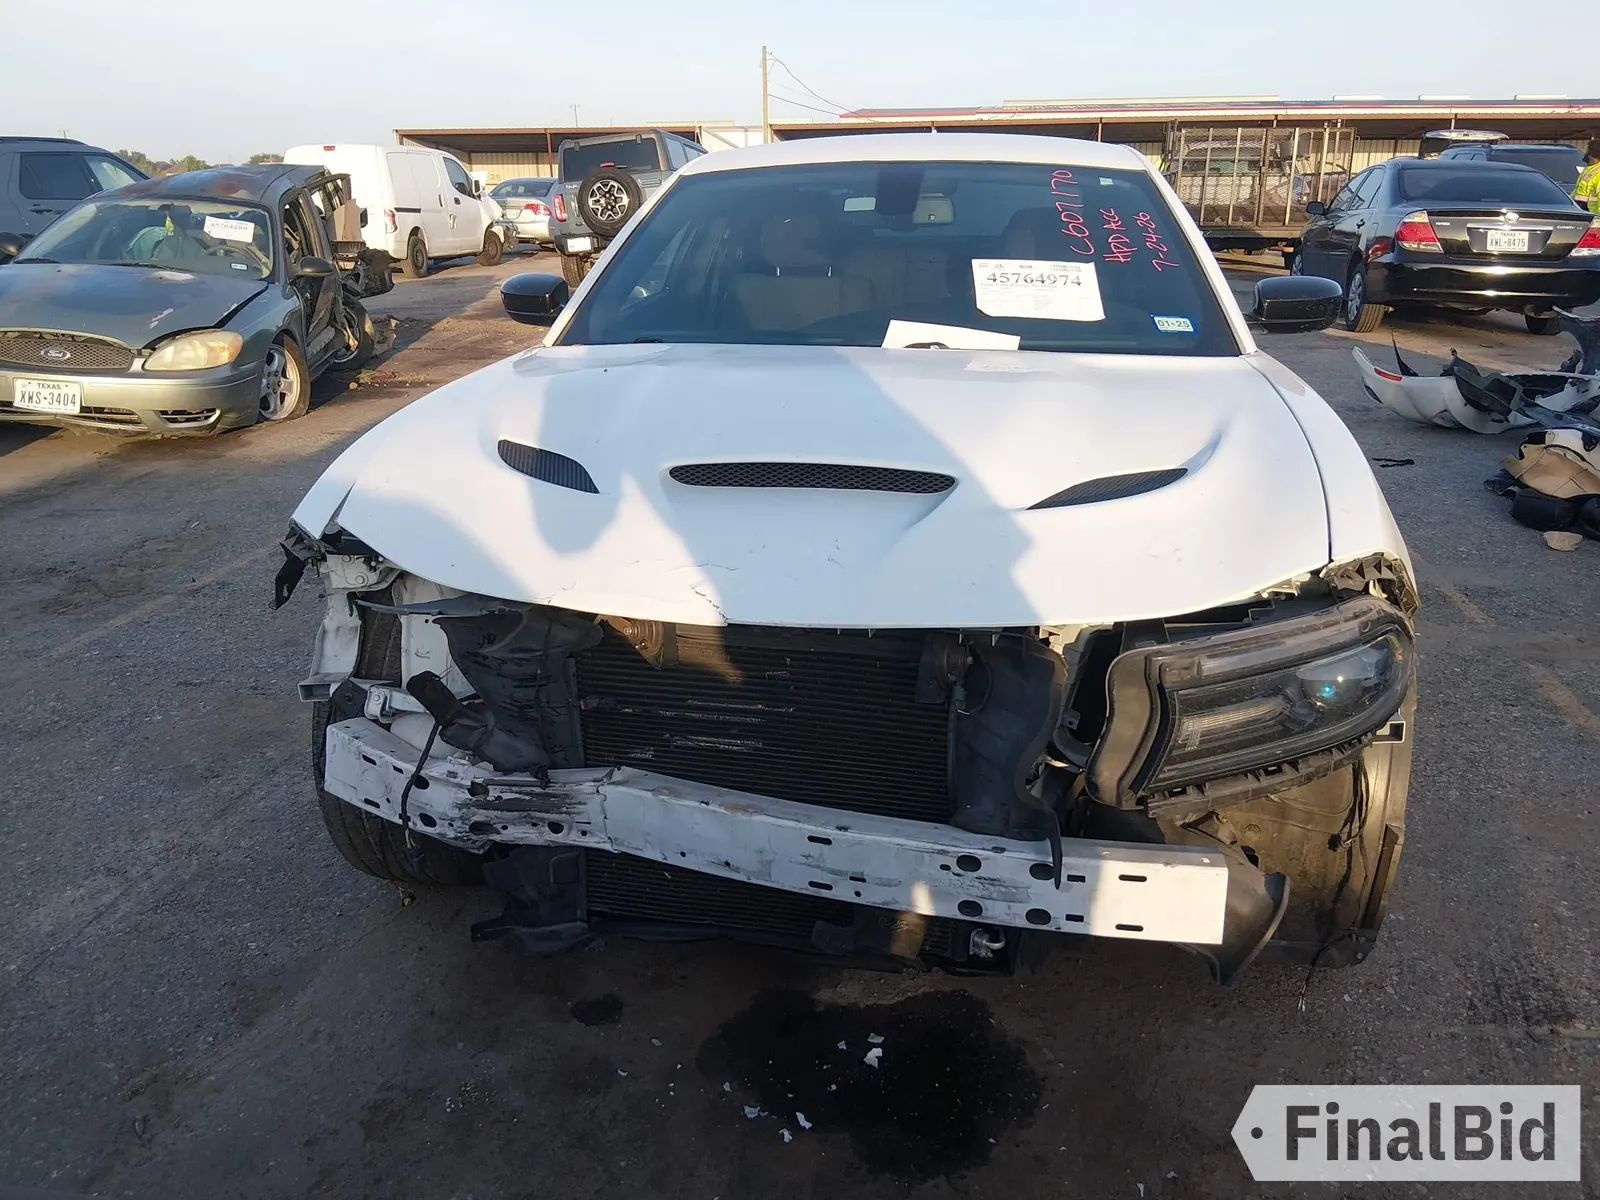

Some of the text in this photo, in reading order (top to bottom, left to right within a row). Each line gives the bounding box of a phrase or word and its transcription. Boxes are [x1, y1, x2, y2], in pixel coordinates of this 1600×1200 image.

[1103, 233, 1138, 262] HPD
[986, 271, 1083, 287] 45764974
[37, 382, 62, 391] TEXAS
